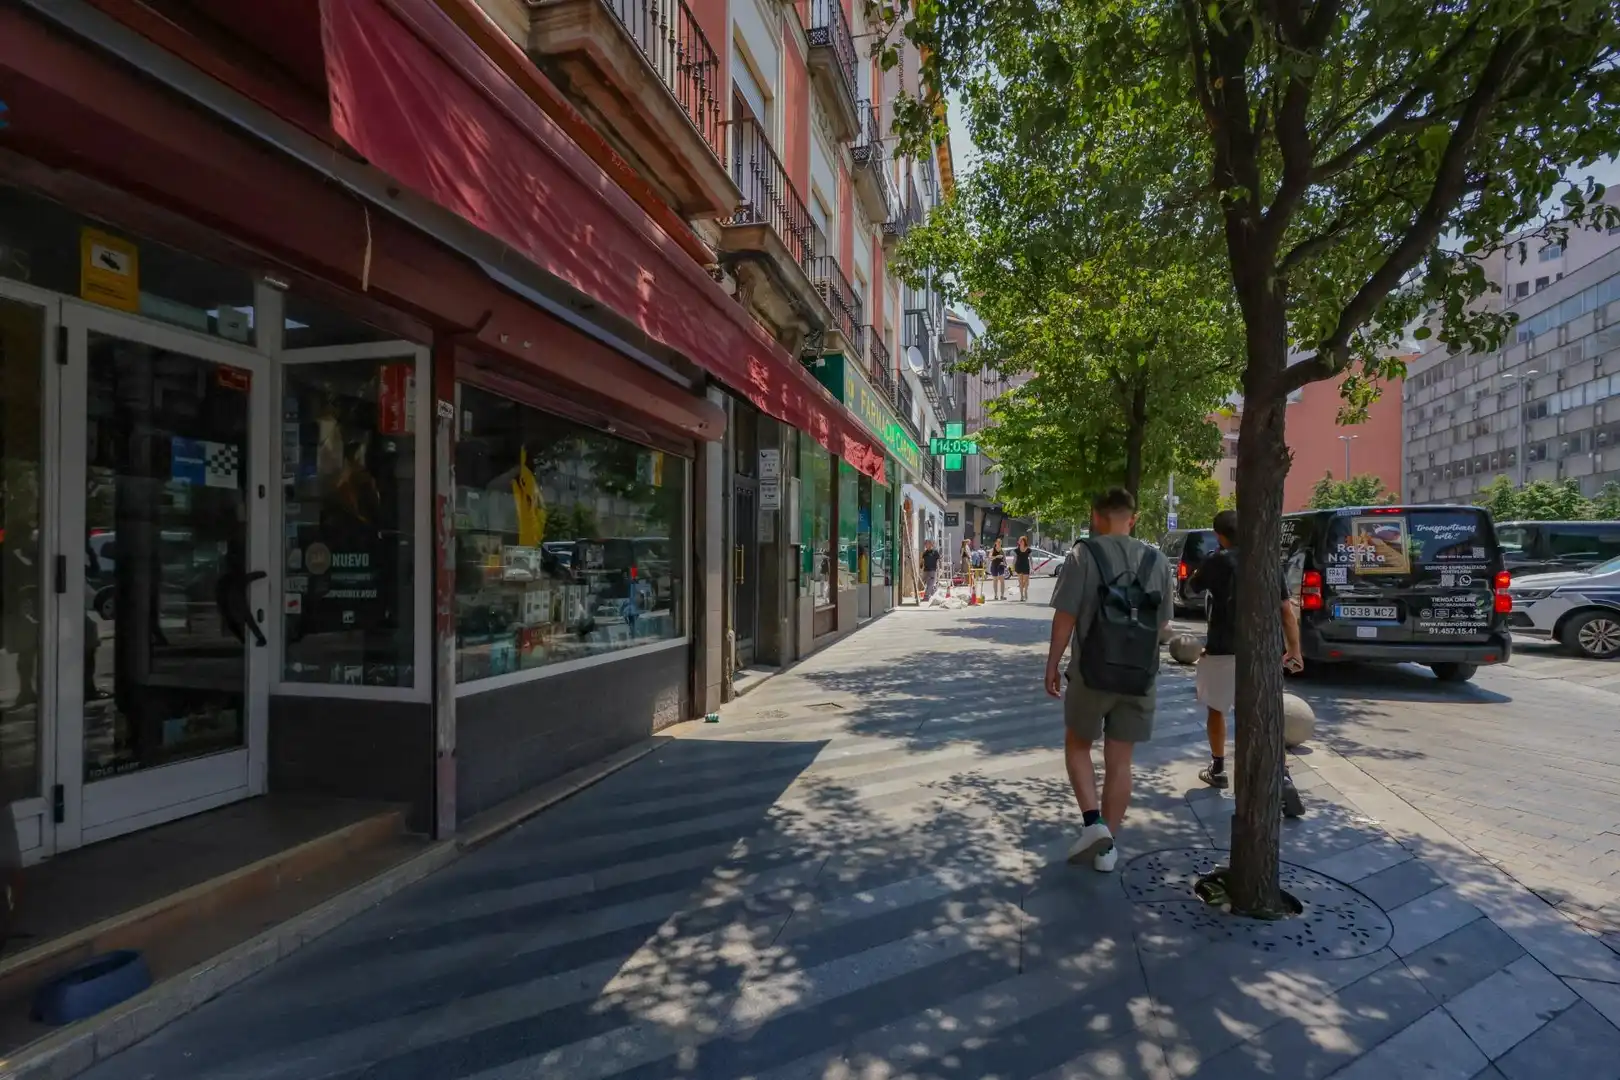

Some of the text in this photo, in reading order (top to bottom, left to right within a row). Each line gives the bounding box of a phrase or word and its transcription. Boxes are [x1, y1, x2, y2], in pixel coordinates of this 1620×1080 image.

[937, 440, 968, 452] 14:03
[332, 553, 370, 567] NUEVO
[1342, 607, 1396, 617] 0638 MCZ
[1429, 627, 1477, 635] 91.457.15.41
